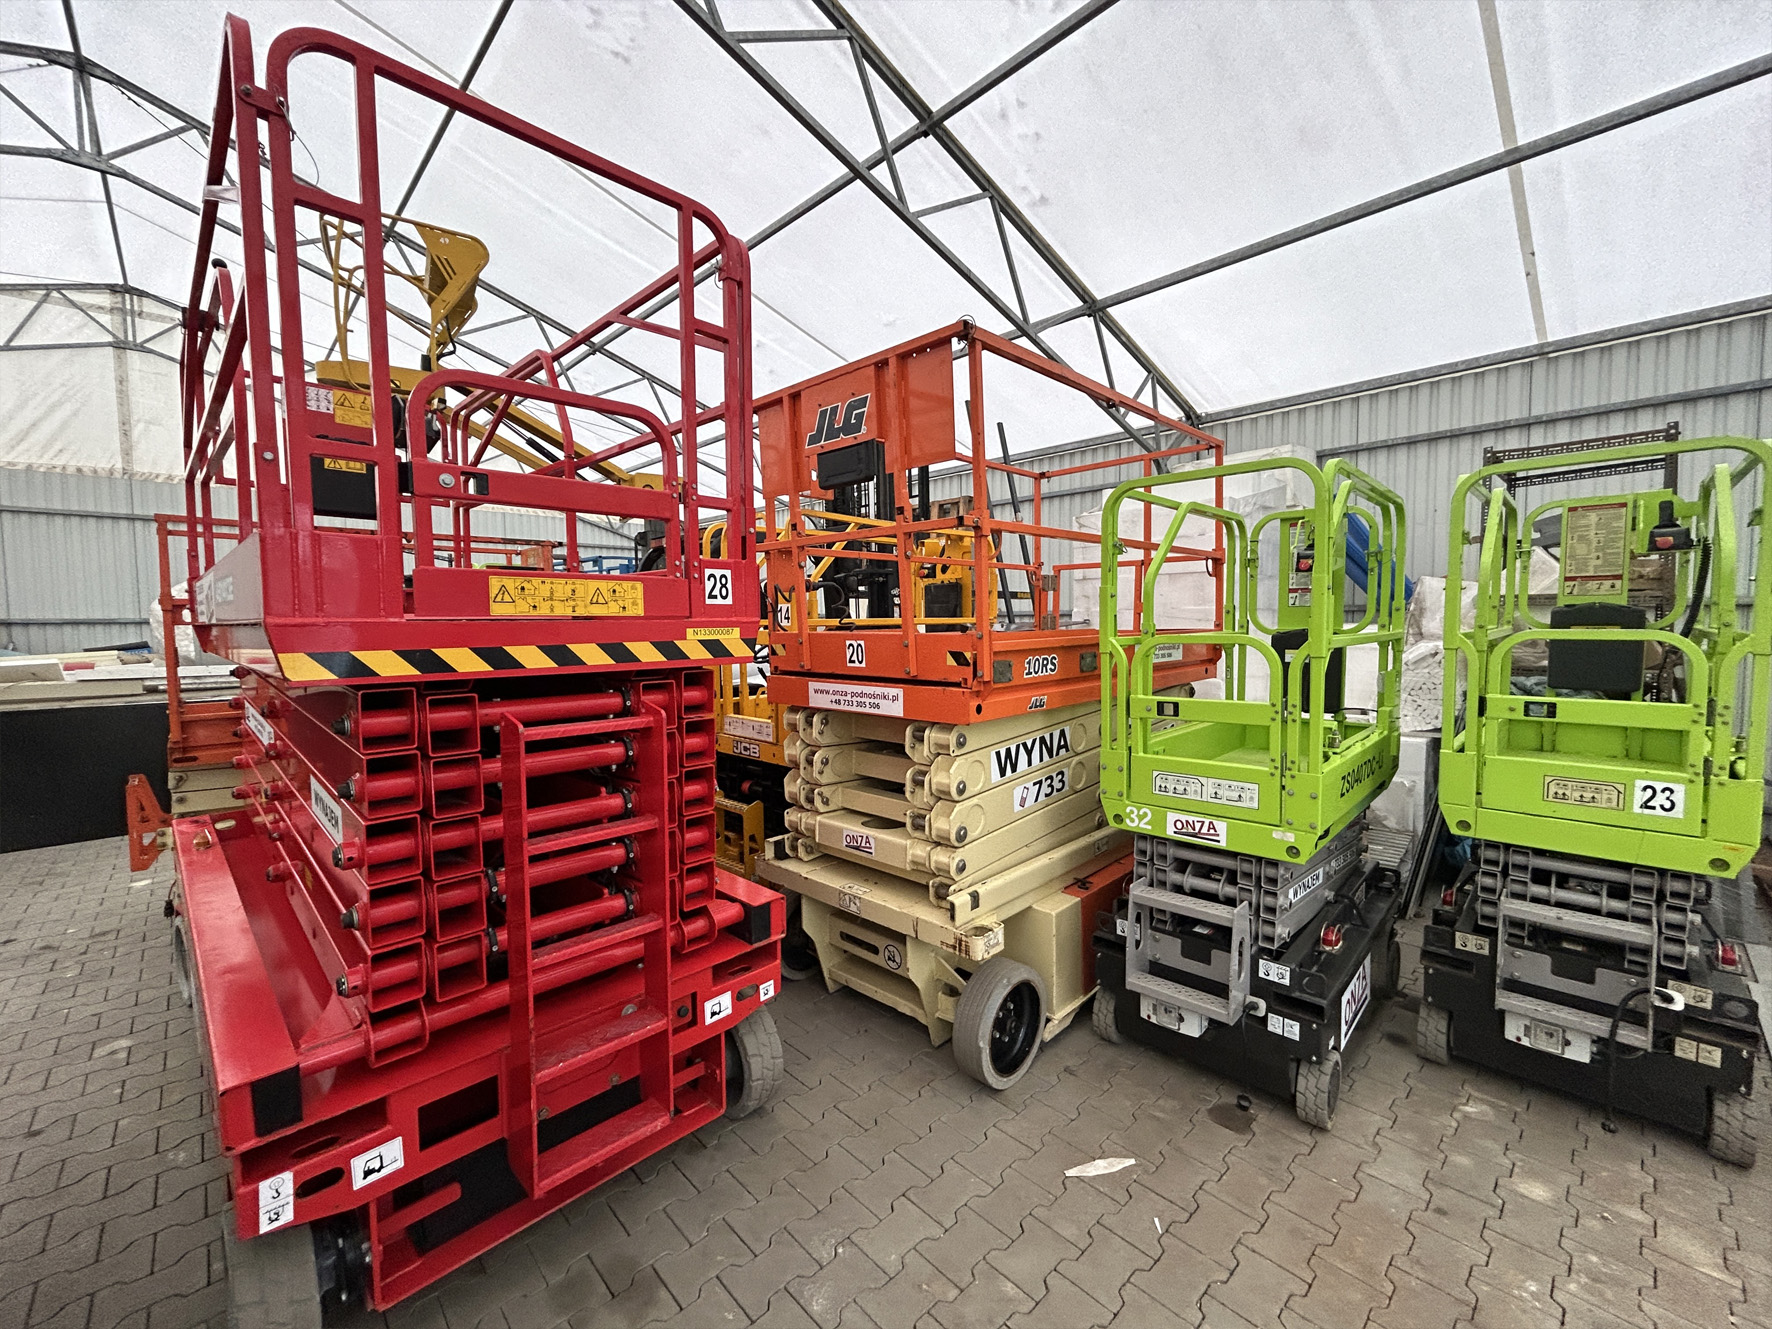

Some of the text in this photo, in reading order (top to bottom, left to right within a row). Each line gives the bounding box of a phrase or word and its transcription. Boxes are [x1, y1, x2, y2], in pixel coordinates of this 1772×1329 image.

[805, 393, 871, 448] JLG
[707, 573, 729, 600] 28
[778, 606, 790, 624] 14
[693, 628, 734, 637] N133000087
[847, 643, 864, 665] 20
[1024, 655, 1058, 677] 10RS
[813, 687, 899, 703] www.onza-podnośniki.pl
[843, 699, 854, 707] 733
[855, 701, 867, 709] 305
[868, 702, 881, 710] 506
[1028, 696, 1047, 711] JLG
[734, 740, 760, 757] JCB
[995, 728, 1070, 779] WYNA
[1032, 770, 1065, 803] 733
[1640, 785, 1676, 812] 23
[1126, 806, 1152, 830] 32
[1292, 871, 1321, 900] WYNAJEM
